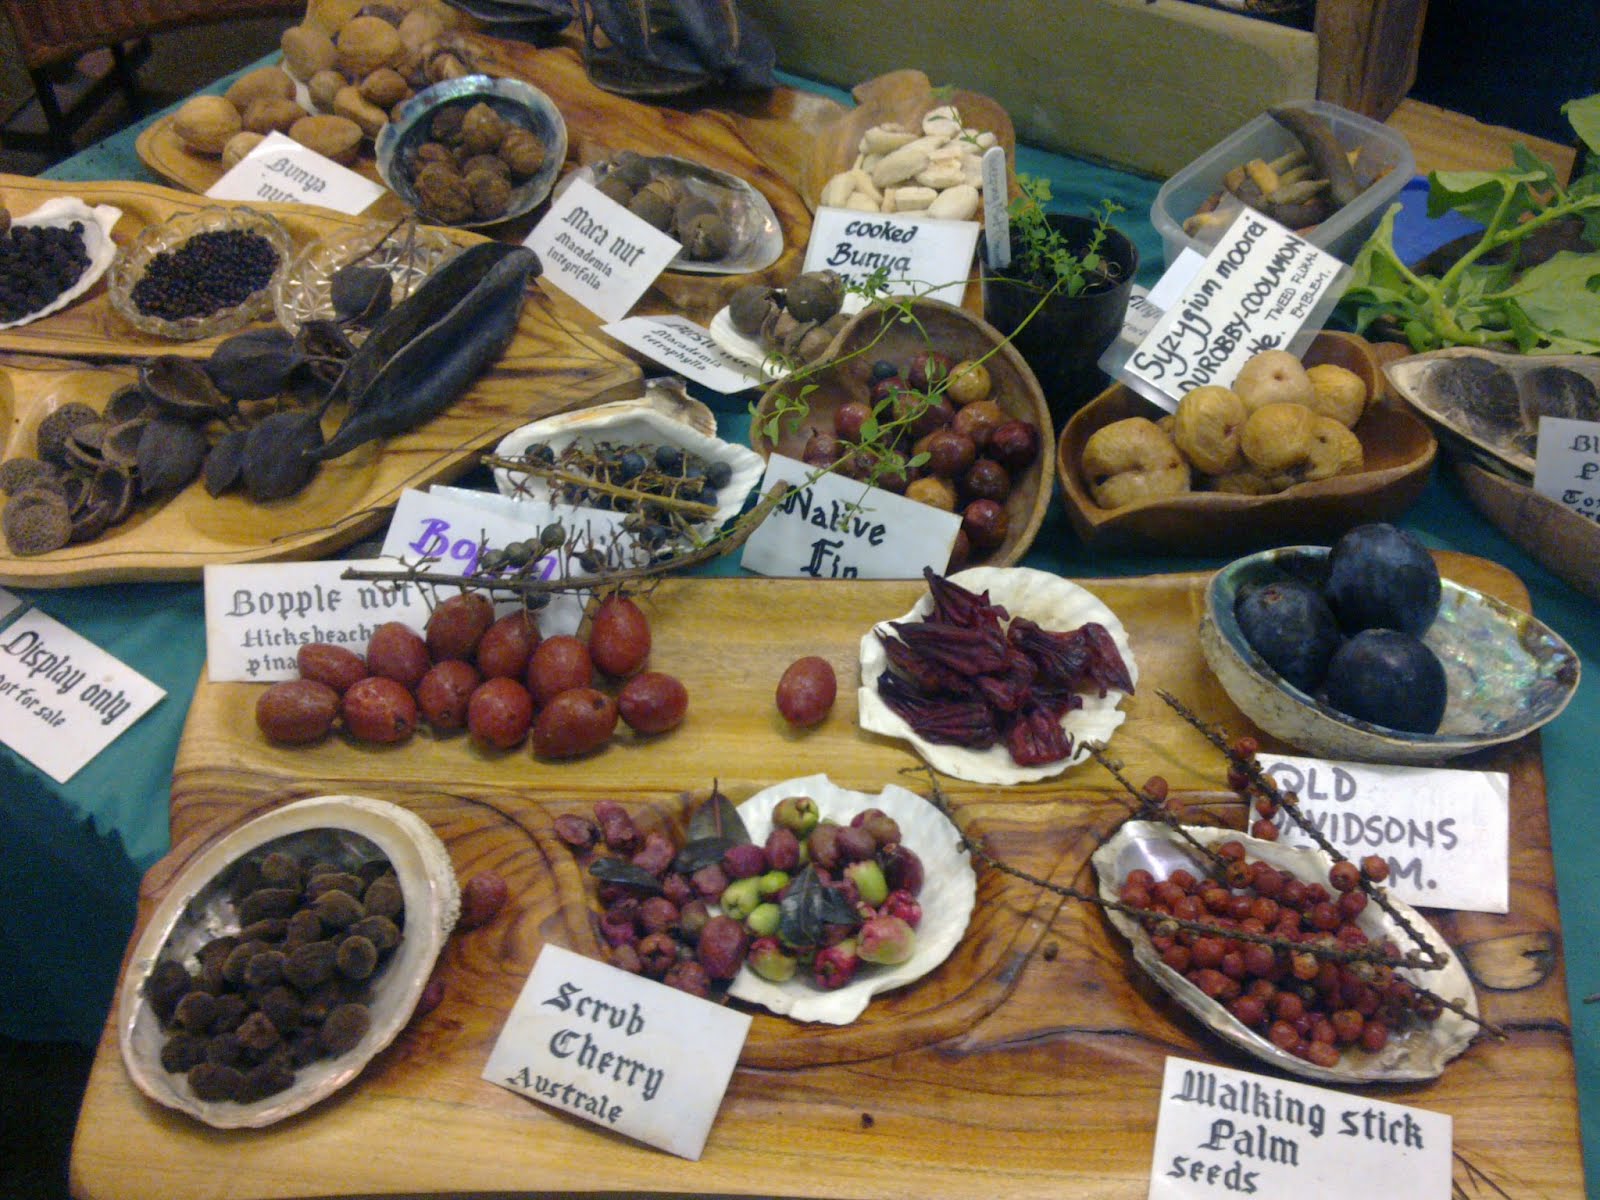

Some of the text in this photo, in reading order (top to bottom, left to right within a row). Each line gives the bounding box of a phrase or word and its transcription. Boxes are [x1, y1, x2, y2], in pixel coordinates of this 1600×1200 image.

[265, 157, 327, 193] Bunya
[561, 205, 646, 268] Maca nut
[845, 220, 919, 244] cooked
[827, 243, 911, 275] Bunya
[1133, 278, 1222, 380] Syzygium
[1216, 215, 1268, 280] moorei
[1264, 287, 1297, 321] TWEED
[225, 583, 413, 620] Bopple nut
[0, 630, 132, 726] Display only
[15, 688, 40, 709] for
[33, 706, 66, 727] sale
[541, 981, 646, 1037] Scrub
[549, 1028, 665, 1101] Cherry
[505, 1066, 624, 1124] Australe
[1170, 1069, 1425, 1150] Walking stick
[1198, 1118, 1300, 1167] Palm
[1166, 1154, 1260, 1195] seeds
